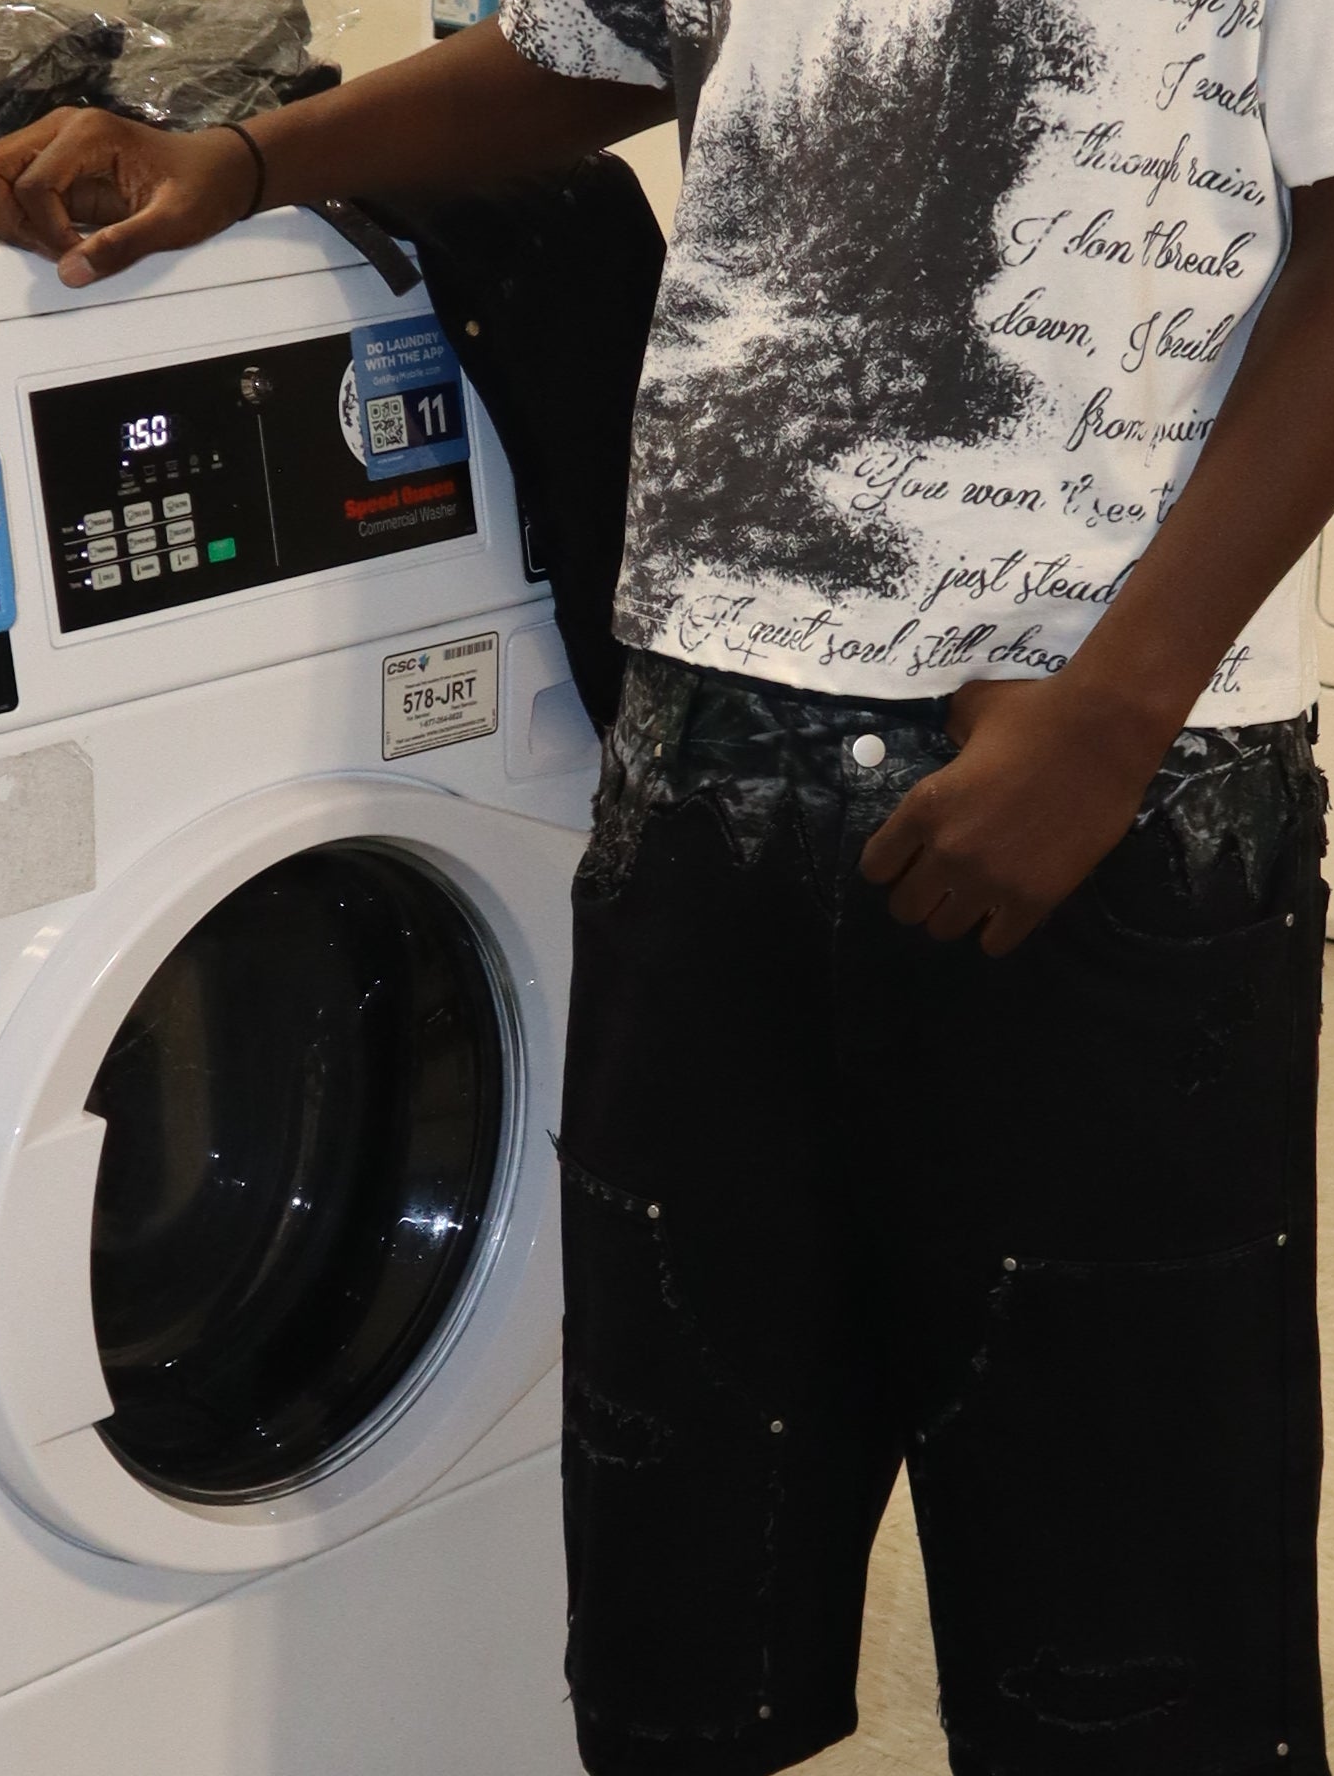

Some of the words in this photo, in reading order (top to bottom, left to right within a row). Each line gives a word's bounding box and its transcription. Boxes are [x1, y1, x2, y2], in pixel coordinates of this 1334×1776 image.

[1074, 120, 1191, 207] through
[1155, 220, 1245, 279] break
[364, 355, 397, 372] WITH
[399, 349, 421, 365] THE
[423, 345, 445, 361] APP
[366, 341, 385, 356] DO
[386, 332, 440, 353] LAUNDRY
[418, 393, 447, 437] 11
[1065, 387, 1147, 452] from
[358, 510, 418, 538] Commercial
[419, 503, 457, 524] Washer
[918, 549, 1028, 612] just
[1013, 554, 1140, 605] stead
[386, 657, 417, 676] CSC
[403, 677, 477, 715] 578-JRT
